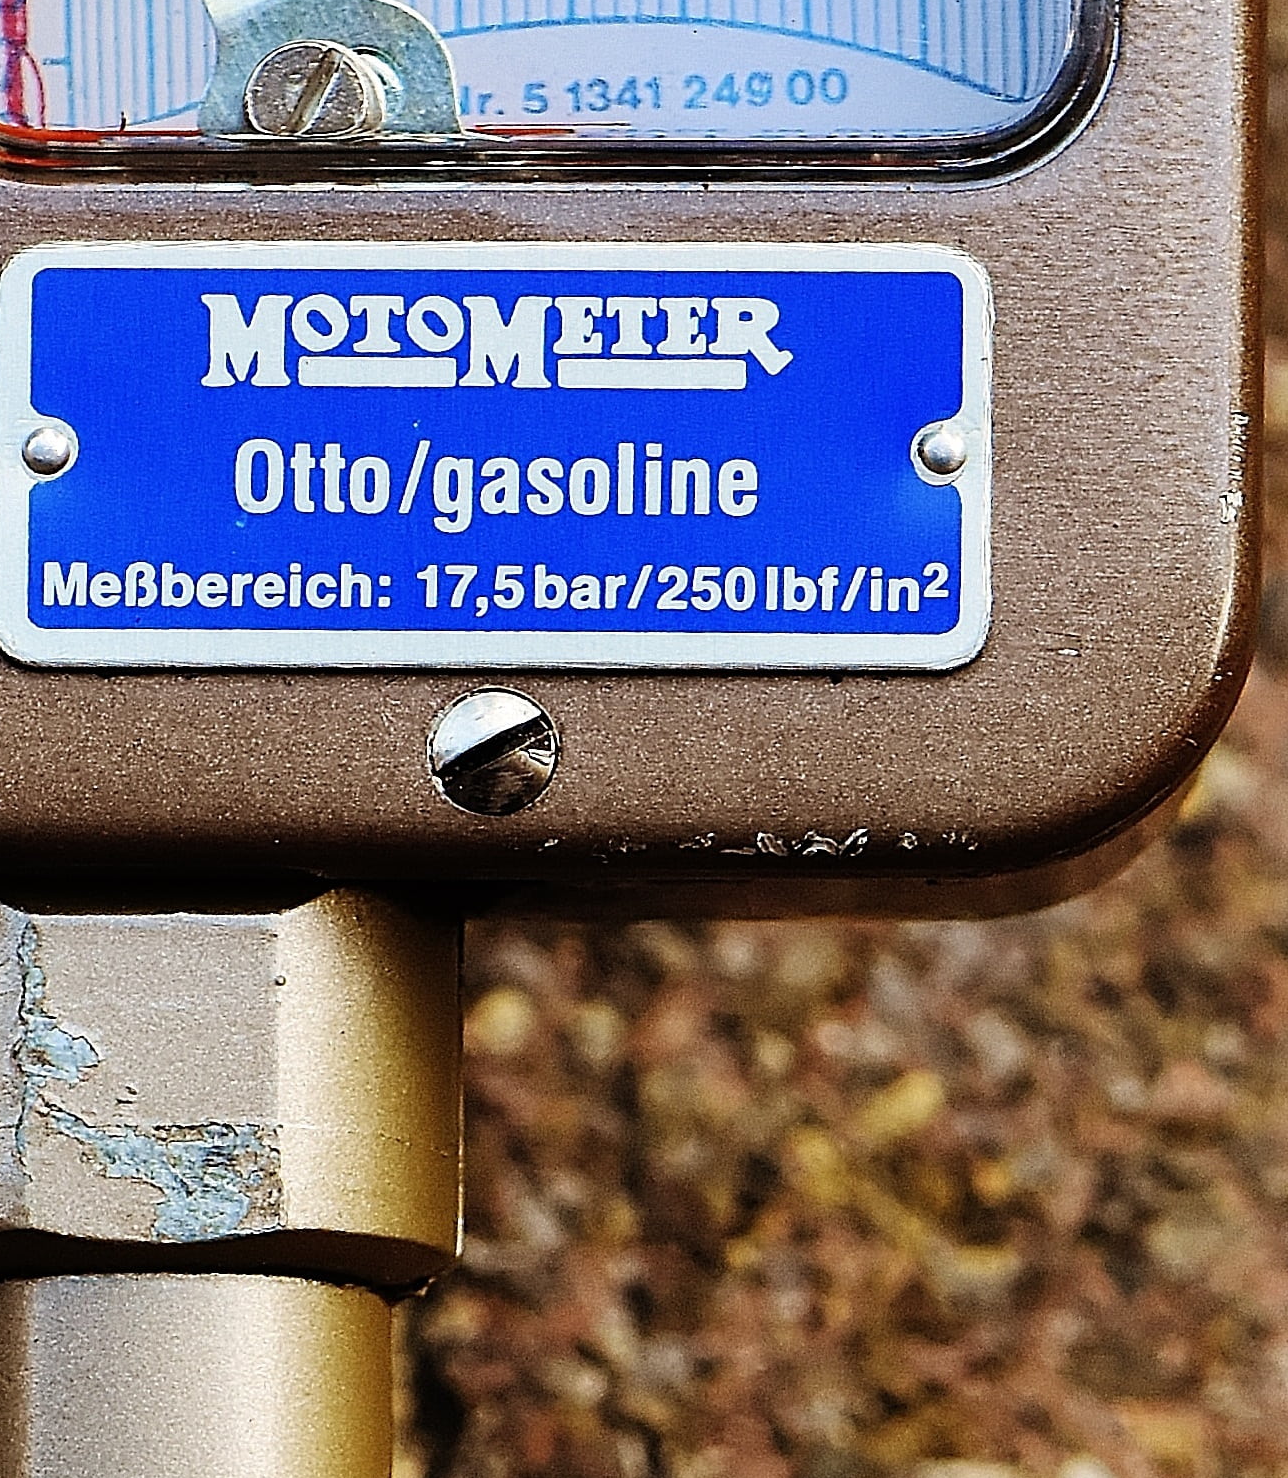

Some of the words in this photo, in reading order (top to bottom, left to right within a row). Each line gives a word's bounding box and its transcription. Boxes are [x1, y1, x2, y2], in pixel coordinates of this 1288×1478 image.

[521, 82, 549, 114] 5
[566, 76, 662, 113] 1341
[683, 71, 773, 109] 249
[786, 67, 849, 106] 00
[234, 438, 760, 534] Otto/gasoline
[41, 560, 393, 609] Meßbereich:
[416, 563, 524, 618] 17,5
[533, 563, 757, 612] bar/250
